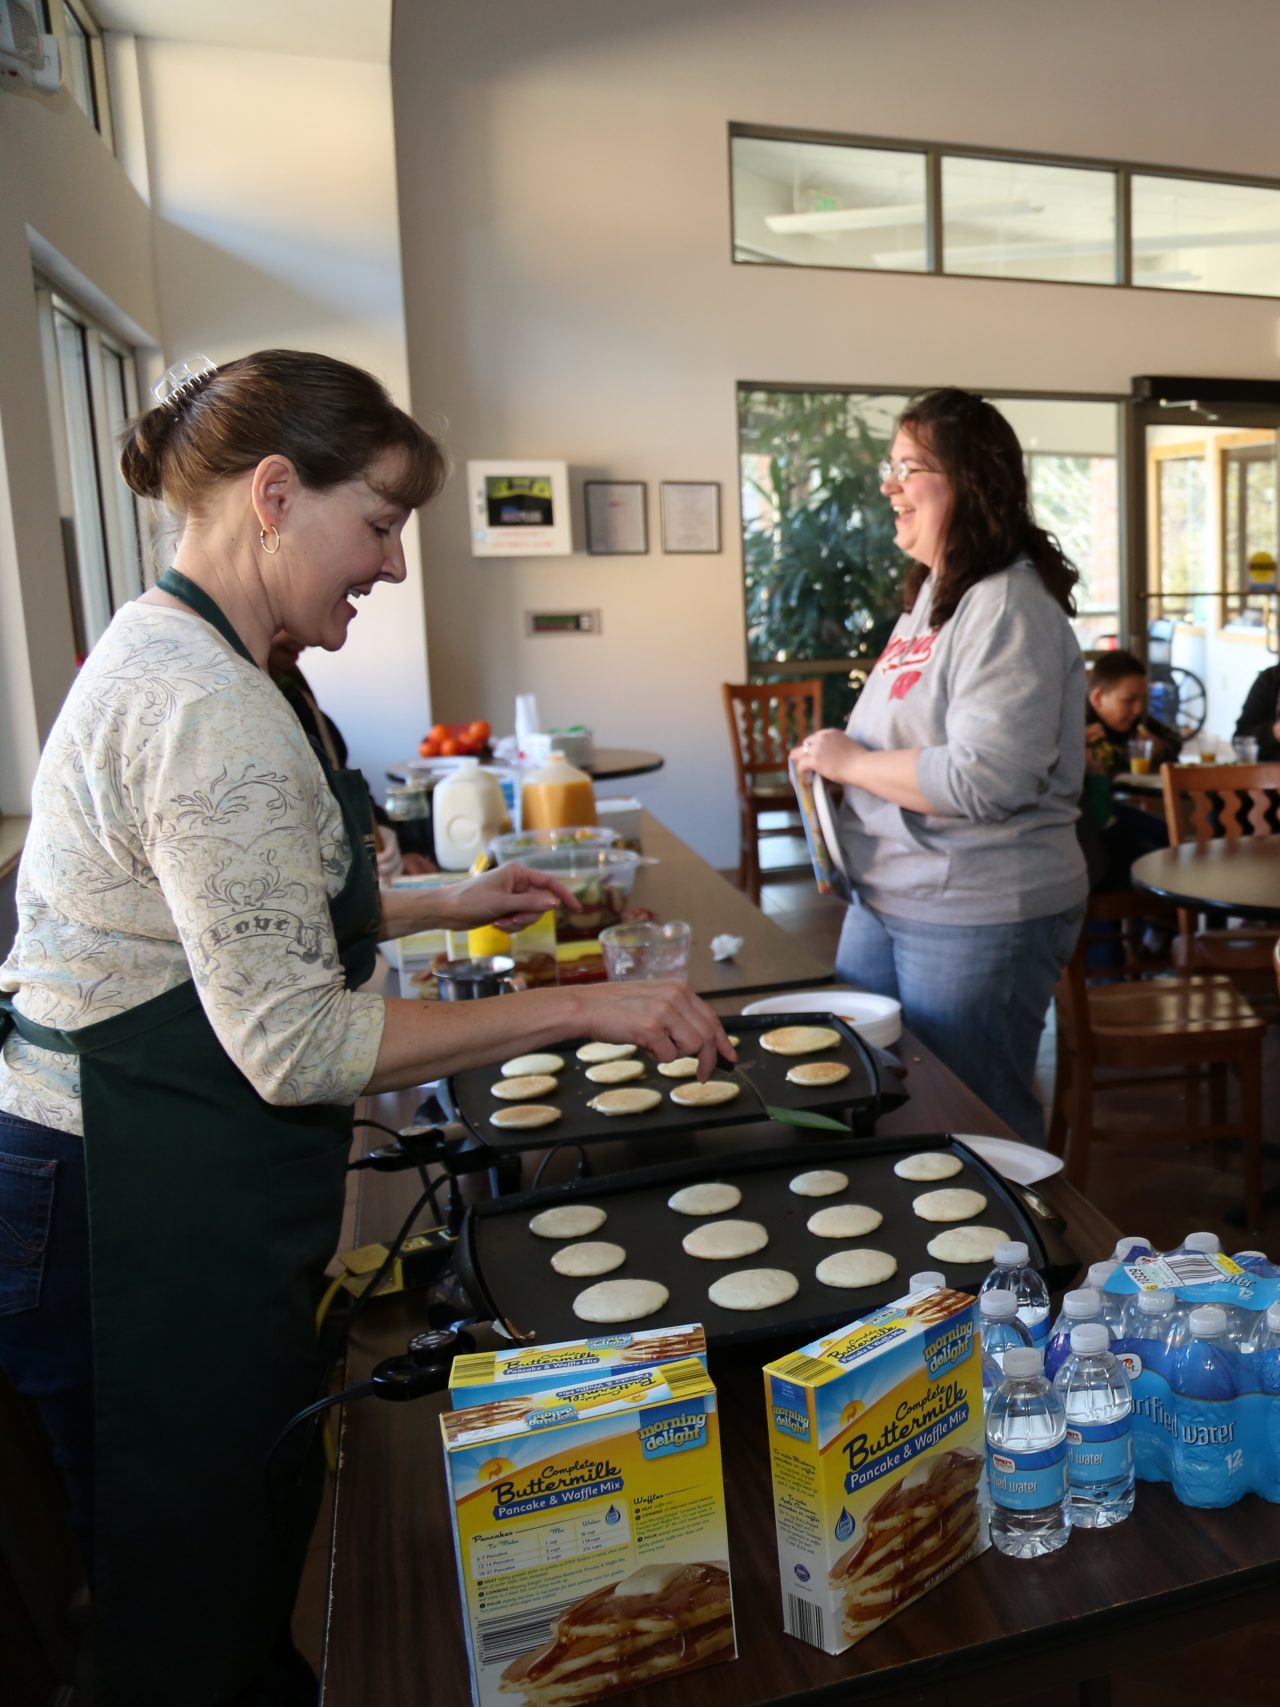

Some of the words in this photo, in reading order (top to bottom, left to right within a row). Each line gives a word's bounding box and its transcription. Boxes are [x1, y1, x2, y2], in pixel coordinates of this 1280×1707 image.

[1222, 1273, 1257, 1288] ater
[827, 1326, 897, 1360] Buttermilk
[924, 1321, 974, 1360] morning
[504, 1352, 599, 1370] Buttermilk
[506, 1366, 542, 1375] Pancake
[552, 1360, 580, 1370] Waffle
[582, 1358, 598, 1366] Mix
[930, 1338, 969, 1372] delight
[559, 1378, 656, 1402] Buttermilk
[896, 1384, 945, 1420] Complete
[638, 1412, 708, 1440] morning
[646, 1425, 700, 1451] delight
[843, 1381, 967, 1471] Buttermilk
[1181, 1421, 1236, 1447] water
[850, 1452, 900, 1488] Pancake
[904, 1444, 912, 1459] &
[914, 1423, 948, 1448] Waffle
[950, 1409, 967, 1428] Mix
[1075, 1452, 1105, 1465] water
[1225, 1449, 1244, 1472] 12
[542, 1459, 596, 1480] Complete
[491, 1460, 622, 1506] Buttermilk
[1009, 1480, 1038, 1494] water
[498, 1500, 546, 1517] Pancake
[550, 1494, 558, 1505] &
[562, 1487, 598, 1502] Waffle
[600, 1482, 621, 1494] Mix
[634, 1494, 664, 1504] Waffles
[472, 1531, 514, 1543] Pancakes
